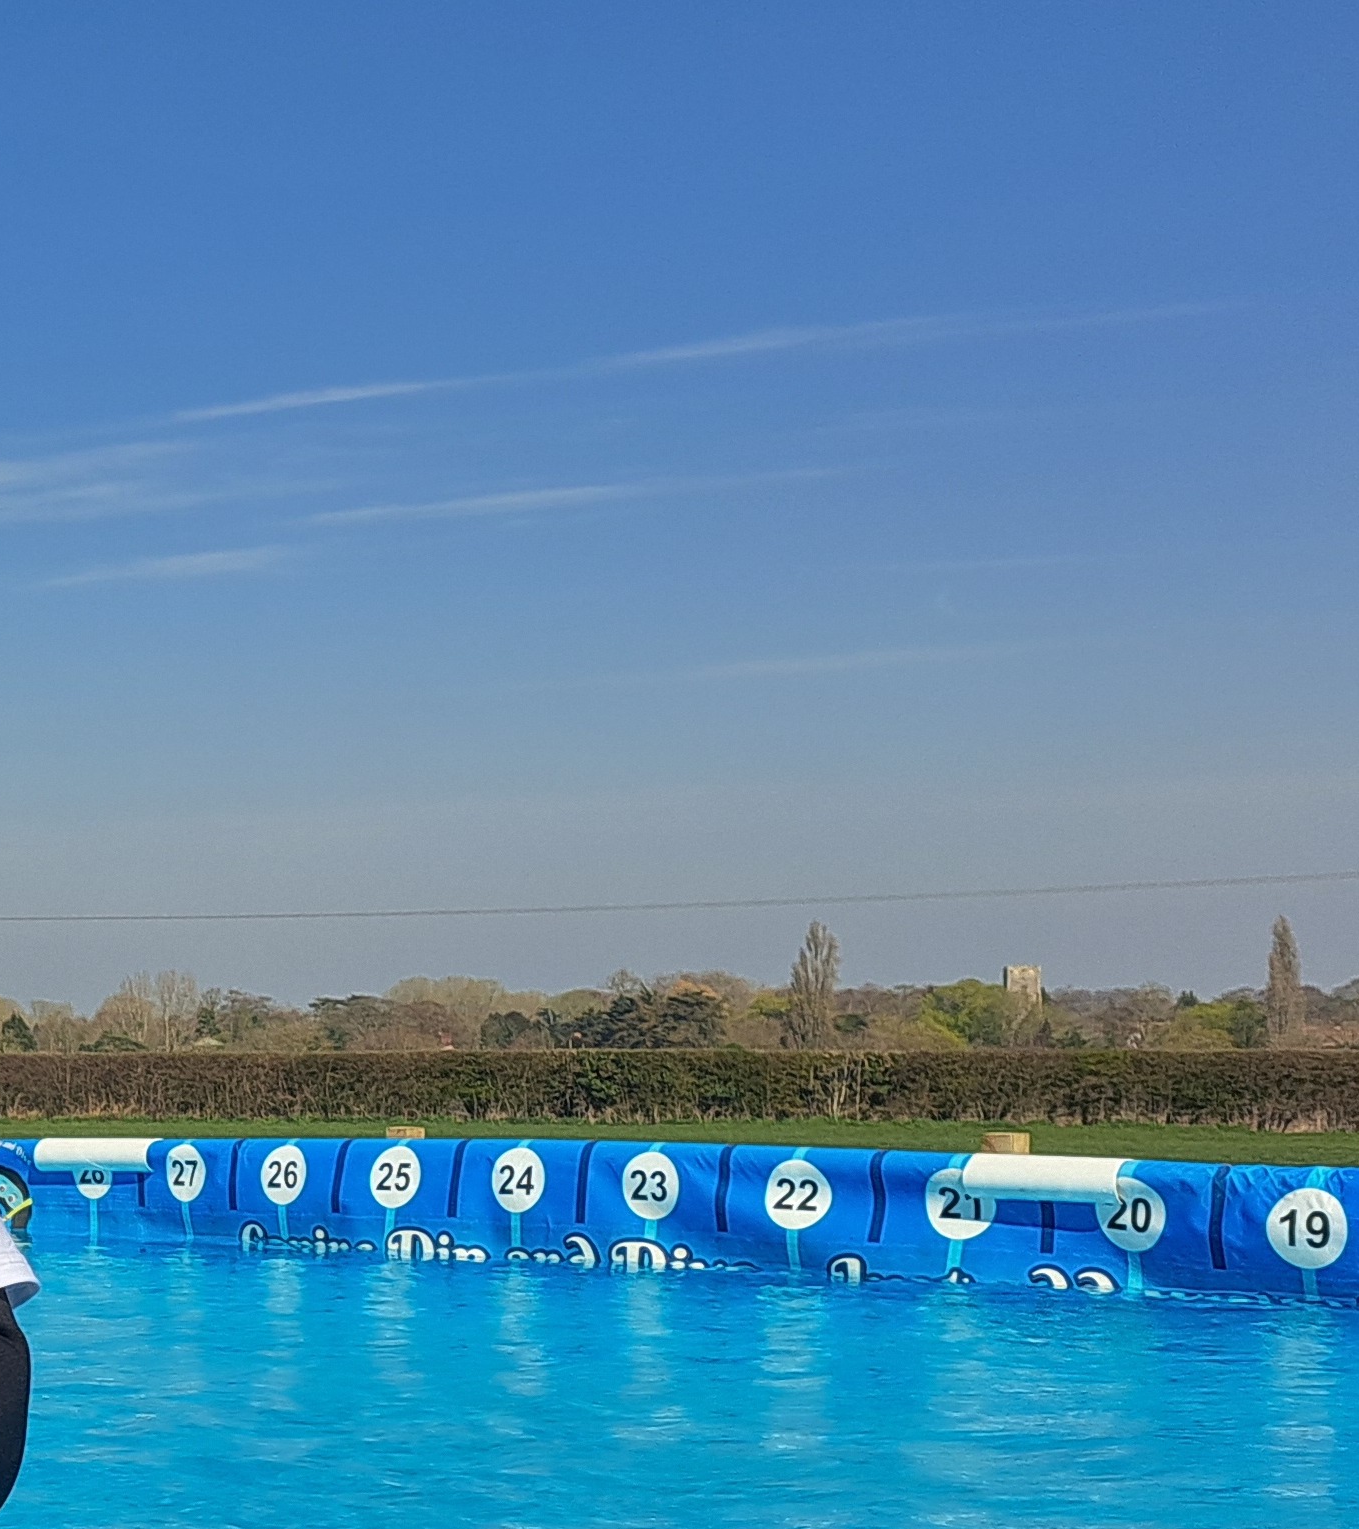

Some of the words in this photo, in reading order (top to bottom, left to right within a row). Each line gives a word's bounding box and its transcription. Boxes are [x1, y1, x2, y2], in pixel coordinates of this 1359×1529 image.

[171, 1160, 199, 1187] 27
[267, 1160, 299, 1189] 26
[375, 1162, 412, 1191] 25
[498, 1164, 535, 1196] 24
[629, 1169, 668, 1202] 23
[772, 1177, 820, 1212] 22
[938, 1186, 981, 1222] 21
[1106, 1197, 1152, 1233] 20
[1279, 1208, 1331, 1249] 19
